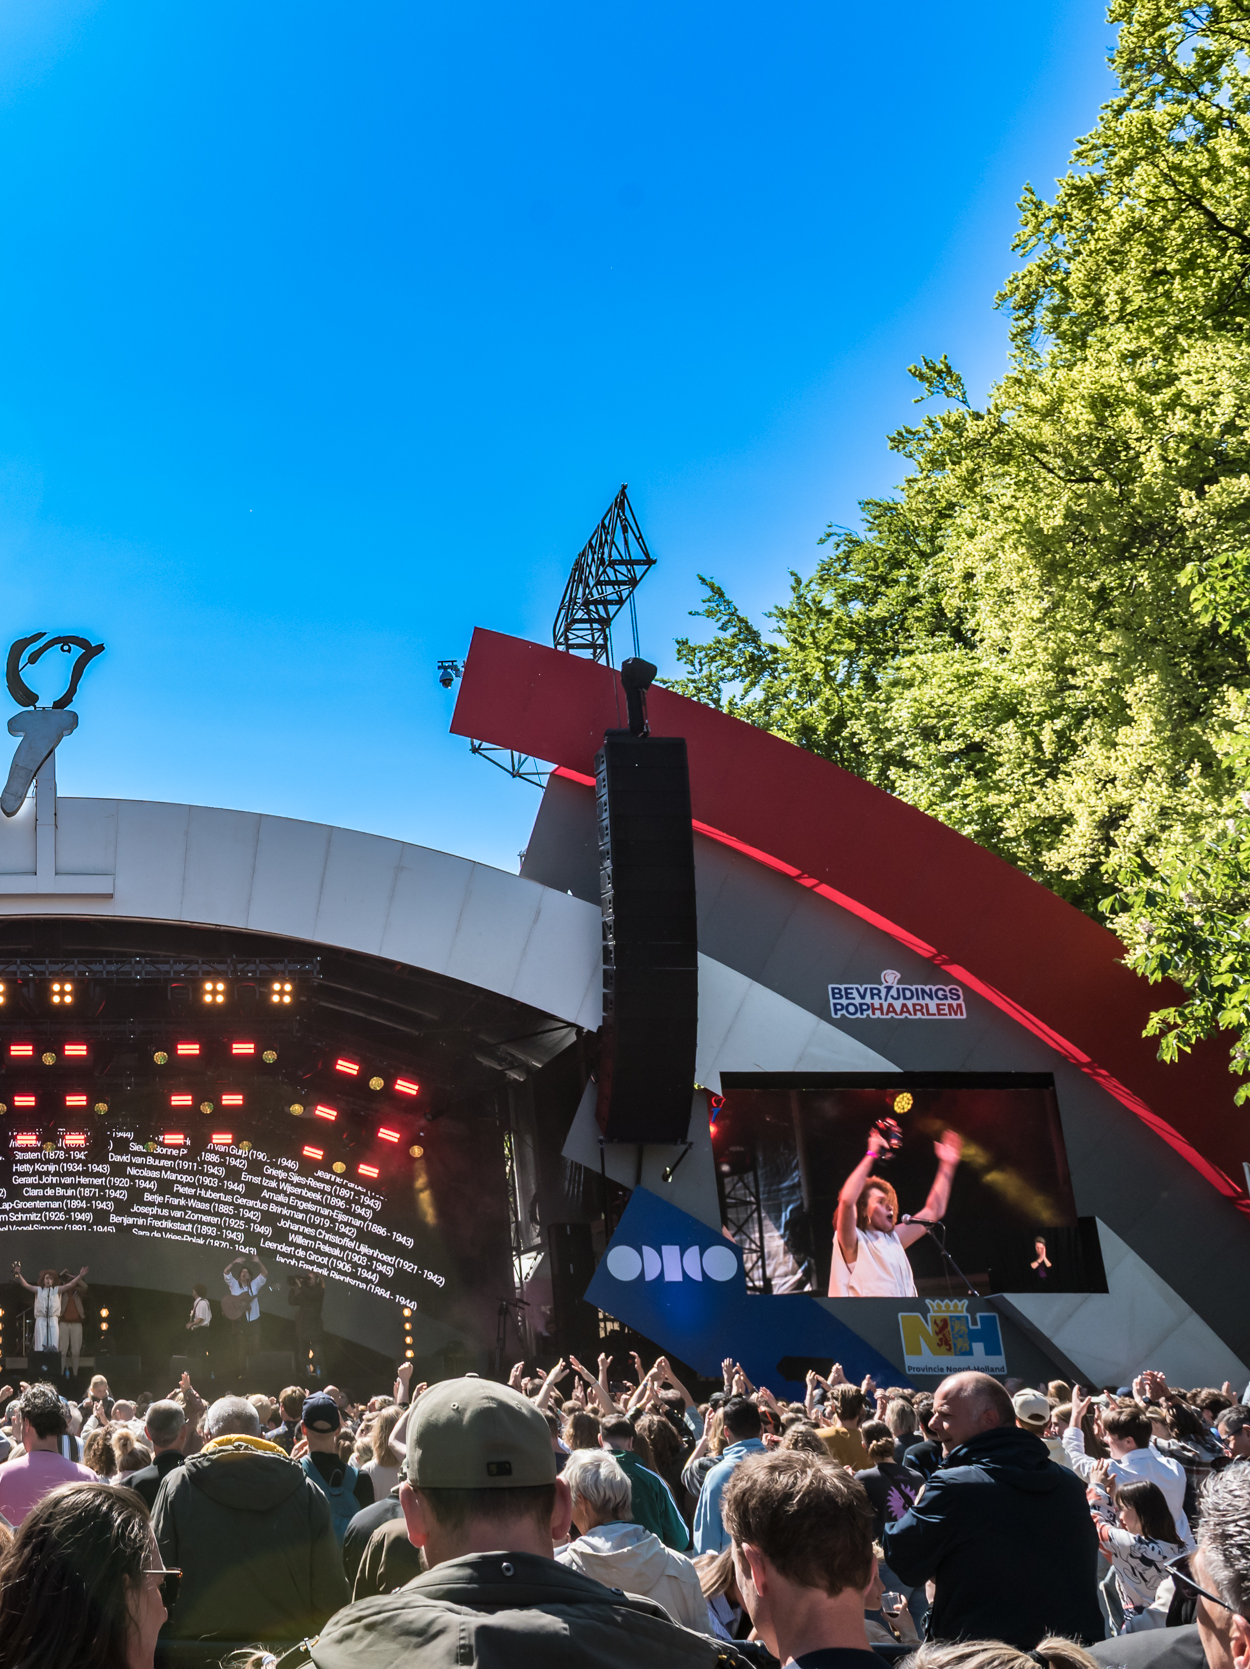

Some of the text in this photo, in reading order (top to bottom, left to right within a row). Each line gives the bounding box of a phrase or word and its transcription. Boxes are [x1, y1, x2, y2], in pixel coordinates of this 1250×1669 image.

[830, 986, 961, 1002] BEVRIJDINGS
[832, 1002, 964, 1016] POPHAARLEM
[12, 1161, 110, 1175] Hetty Konijn (1934 1943)
[108, 1152, 225, 1178] David van Buuren (1911 1943)
[126, 1165, 245, 1194] Nicolaas Manopo (1903 1944)
[11, 1174, 38, 1184] Gerard
[38, 1174, 59, 1184] John
[106, 1176, 130, 1187] (1920
[134, 1178, 157, 1192] 1944)
[22, 1186, 127, 1201] Clara de Bruin (1871 1942)
[240, 1171, 261, 1184] Ernst
[261, 1176, 278, 1188] Izak
[322, 1193, 345, 1208] (1896
[350, 1203, 372, 1220] 1943)
[262, 1164, 288, 1179] Grietje
[331, 1184, 354, 1199] (1891
[359, 1194, 381, 1211] 1943)
[8, 1211, 41, 1221] Schmitz
[41, 1210, 65, 1222] (1926
[70, 1211, 93, 1223] 1949)
[62, 1198, 86, 1210] (1894
[91, 1200, 114, 1212] 1943)
[143, 1191, 261, 1222] Betje Frank-Waas (1885 1942)
[173, 1183, 357, 1238] Pieter Hubertus Gerardus Brinkman (1919 1942)
[260, 1188, 288, 1203] Amalia
[363, 1220, 387, 1236] (1886
[391, 1231, 414, 1249] 1943)
[109, 1213, 146, 1226] Benjamin
[192, 1223, 216, 1236] (1893
[221, 1228, 244, 1243] 1943)
[129, 1203, 272, 1238] Josephus van Zomeren (1925 1949)
[259, 1237, 379, 1284] Leendert de Groot (1906 1944)
[276, 1217, 316, 1236] Johannes
[315, 1228, 356, 1249] Christoffel
[394, 1257, 418, 1274] (1921
[422, 1269, 445, 1287] 1942)
[288, 1232, 315, 1248] Willem
[343, 1249, 367, 1265] (1903
[371, 1260, 394, 1278] 1945)
[907, 1365, 944, 1373] Provincie
